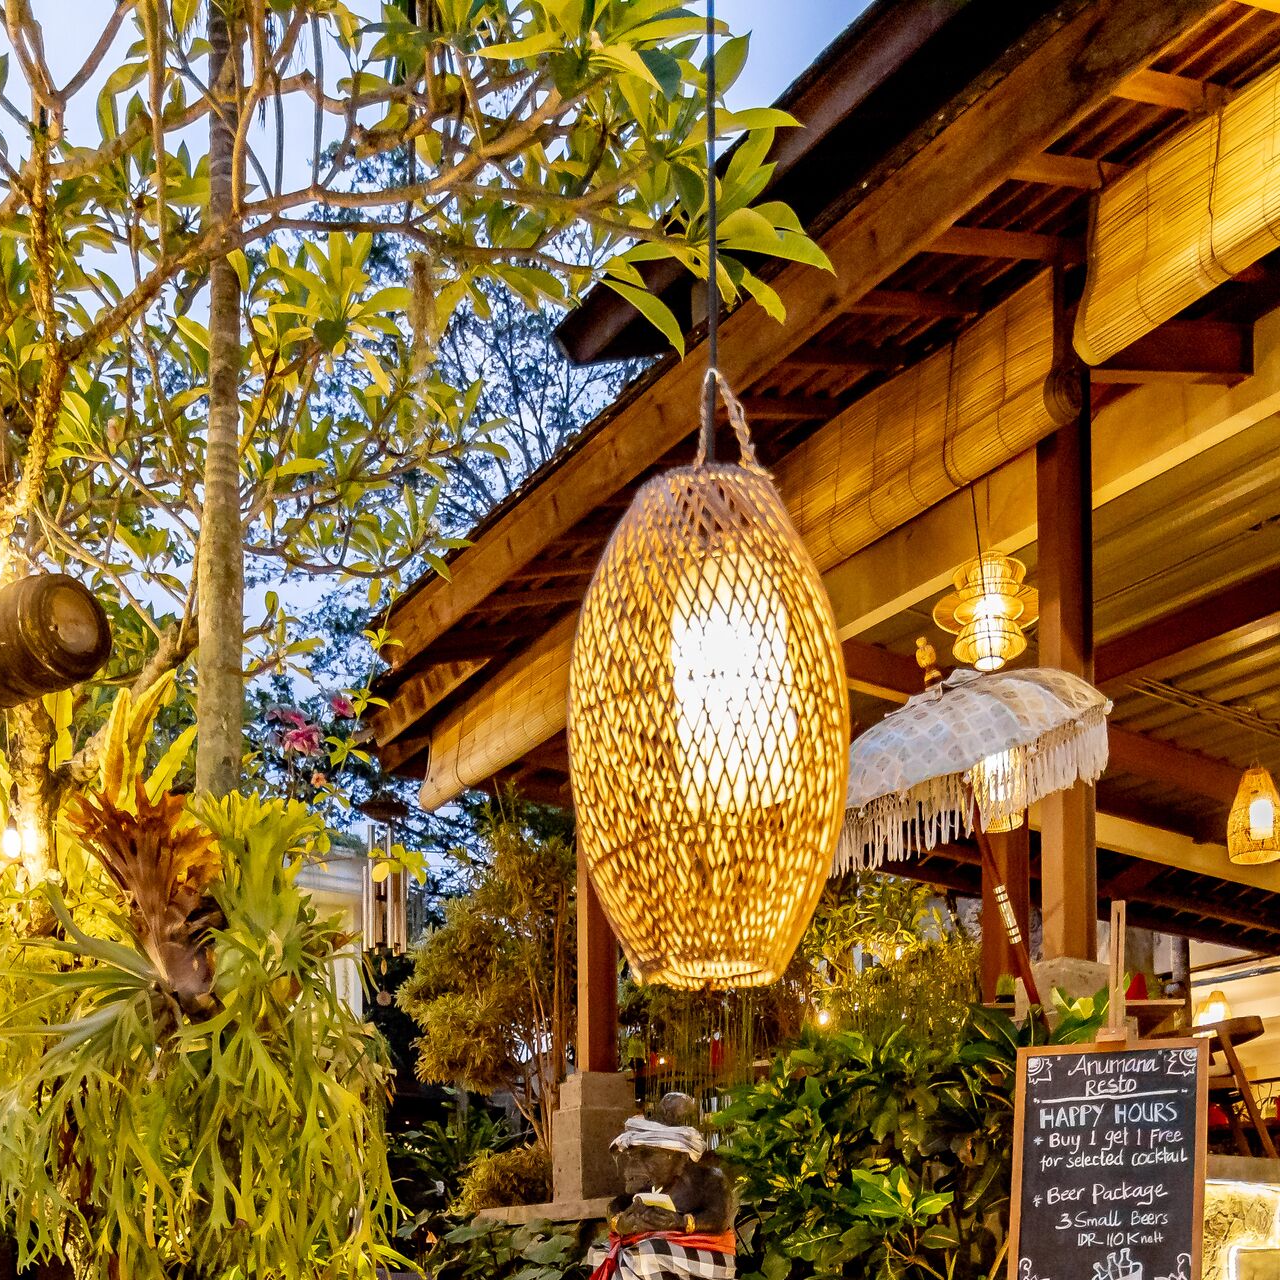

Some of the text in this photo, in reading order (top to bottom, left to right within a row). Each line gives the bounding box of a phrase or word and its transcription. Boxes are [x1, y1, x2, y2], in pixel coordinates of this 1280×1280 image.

[1068, 1055, 1160, 1076] Anumana
[1085, 1074, 1137, 1097] Resto
[1039, 1102, 1178, 1129] HAPPY HOURS
[1049, 1127, 1184, 1154] Buy 1 get 1 Free
[1040, 1147, 1188, 1172] for selected cocktail
[1046, 1181, 1169, 1206] Beer Package
[1055, 1210, 1169, 1230] 3 Small Beers
[1077, 1232, 1104, 1247] IDR
